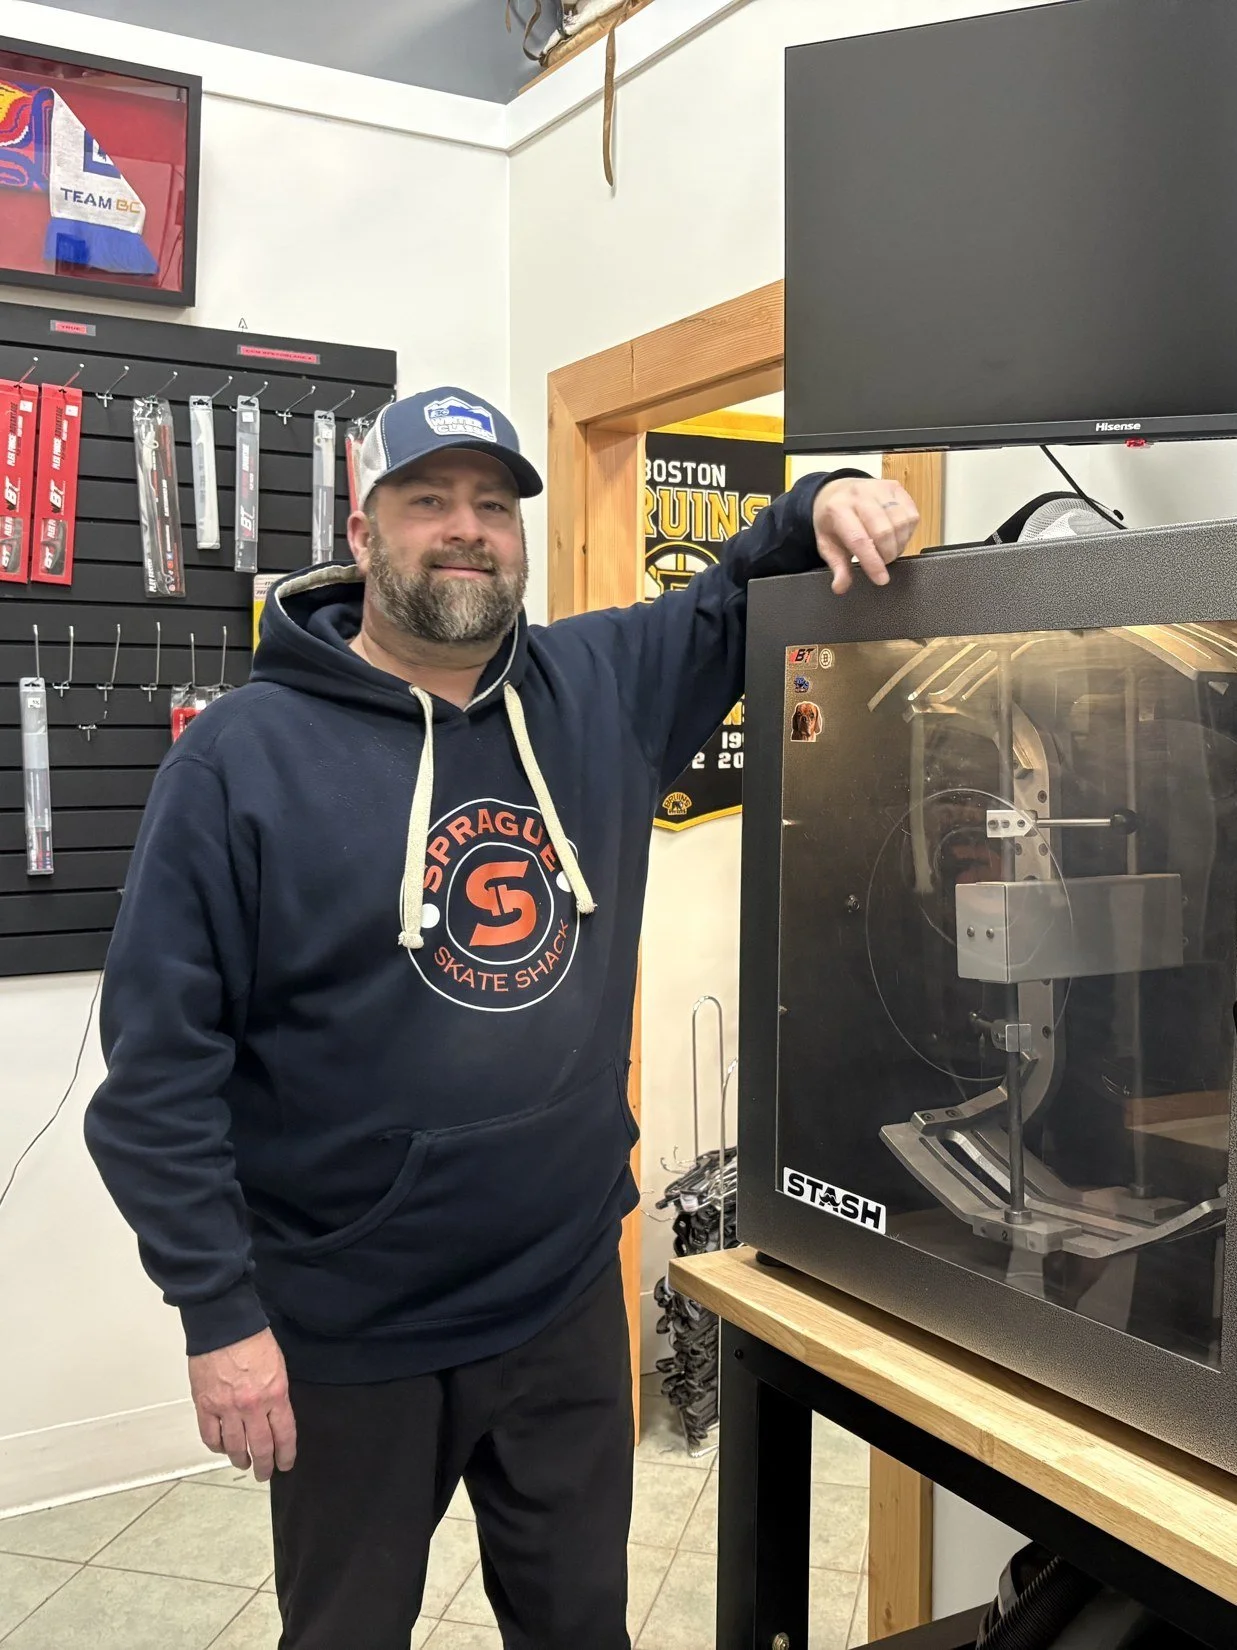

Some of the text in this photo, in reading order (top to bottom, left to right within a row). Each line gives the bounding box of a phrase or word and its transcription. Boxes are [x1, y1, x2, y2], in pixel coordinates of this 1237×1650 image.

[60, 187, 141, 214] TEAM BC
[1095, 422, 1142, 432] Hisense
[4, 476, 20, 506] BT
[49, 479, 65, 509] BT
[240, 505, 255, 531] BT
[795, 648, 816, 663] BT
[722, 731, 744, 749] 19
[423, 808, 557, 894] SPRAGUE
[433, 918, 569, 992] SKATE SHACK
[787, 1172, 882, 1230] STASH
